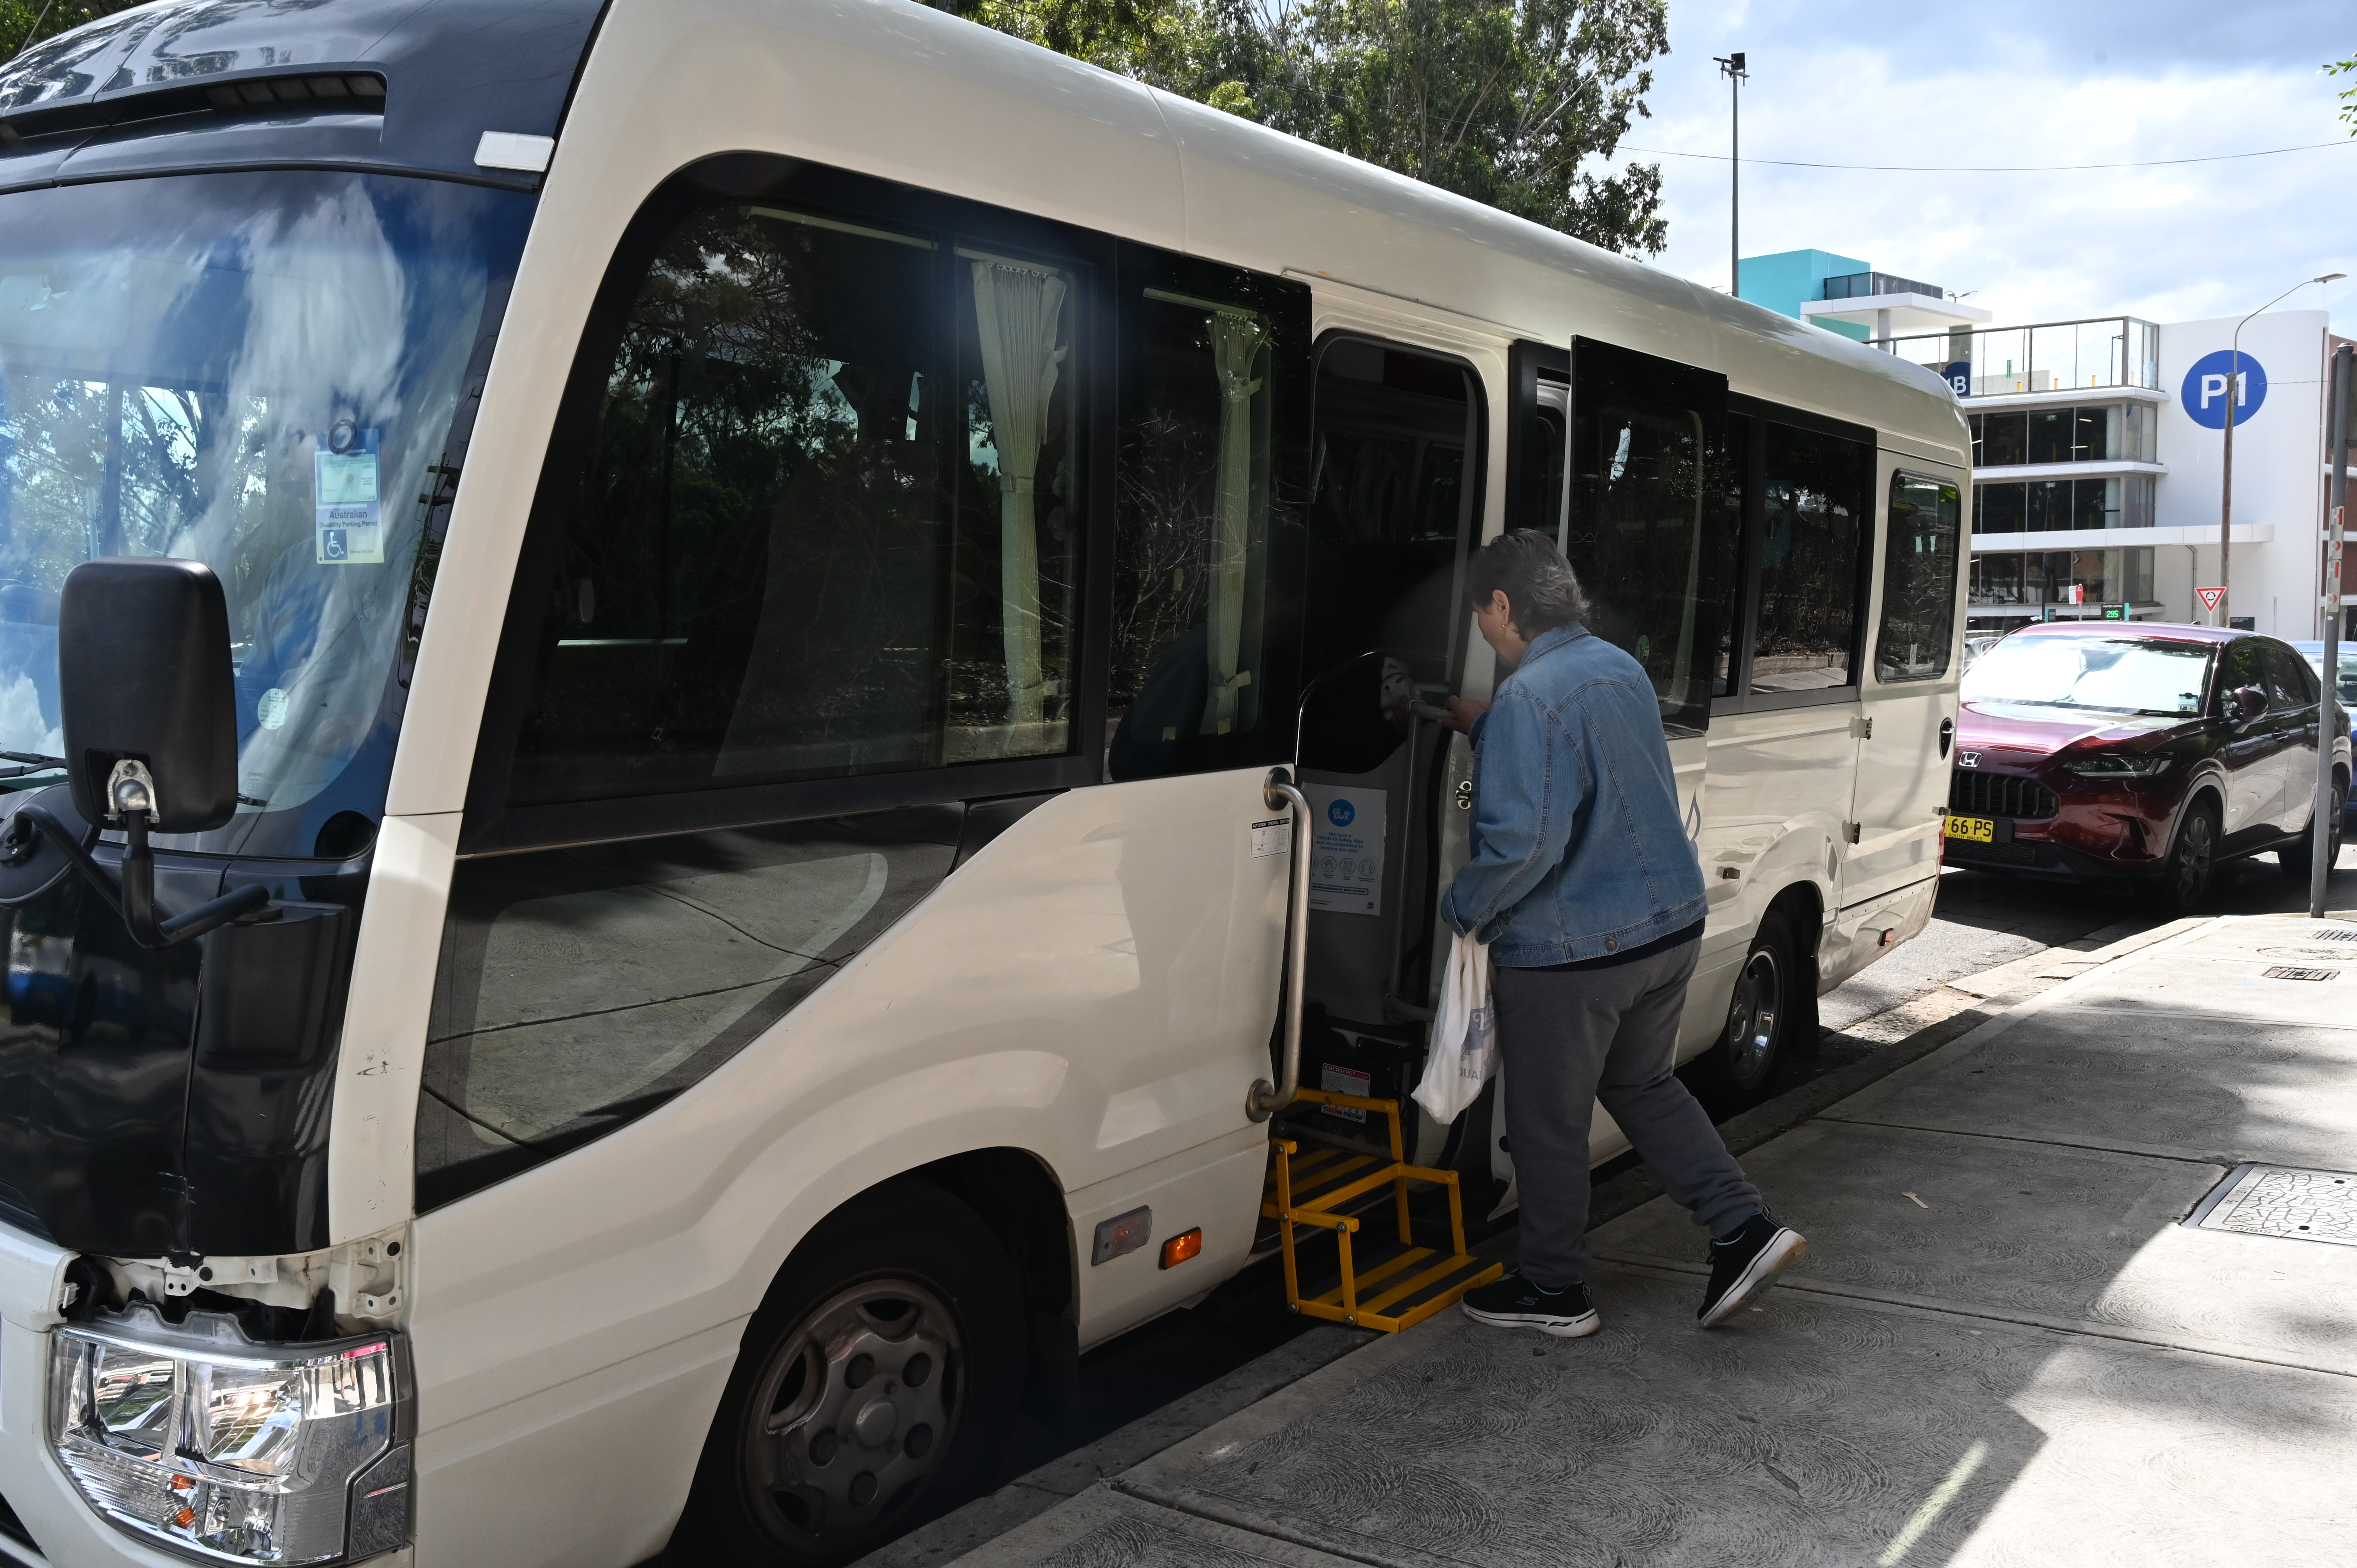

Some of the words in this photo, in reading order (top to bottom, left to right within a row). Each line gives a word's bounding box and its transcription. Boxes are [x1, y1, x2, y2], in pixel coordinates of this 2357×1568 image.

[1947, 376, 1967, 394] B
[2201, 371, 2246, 409] P1
[329, 510, 367, 519] Australian
[1325, 1065, 1356, 1076] EMERGENCY
